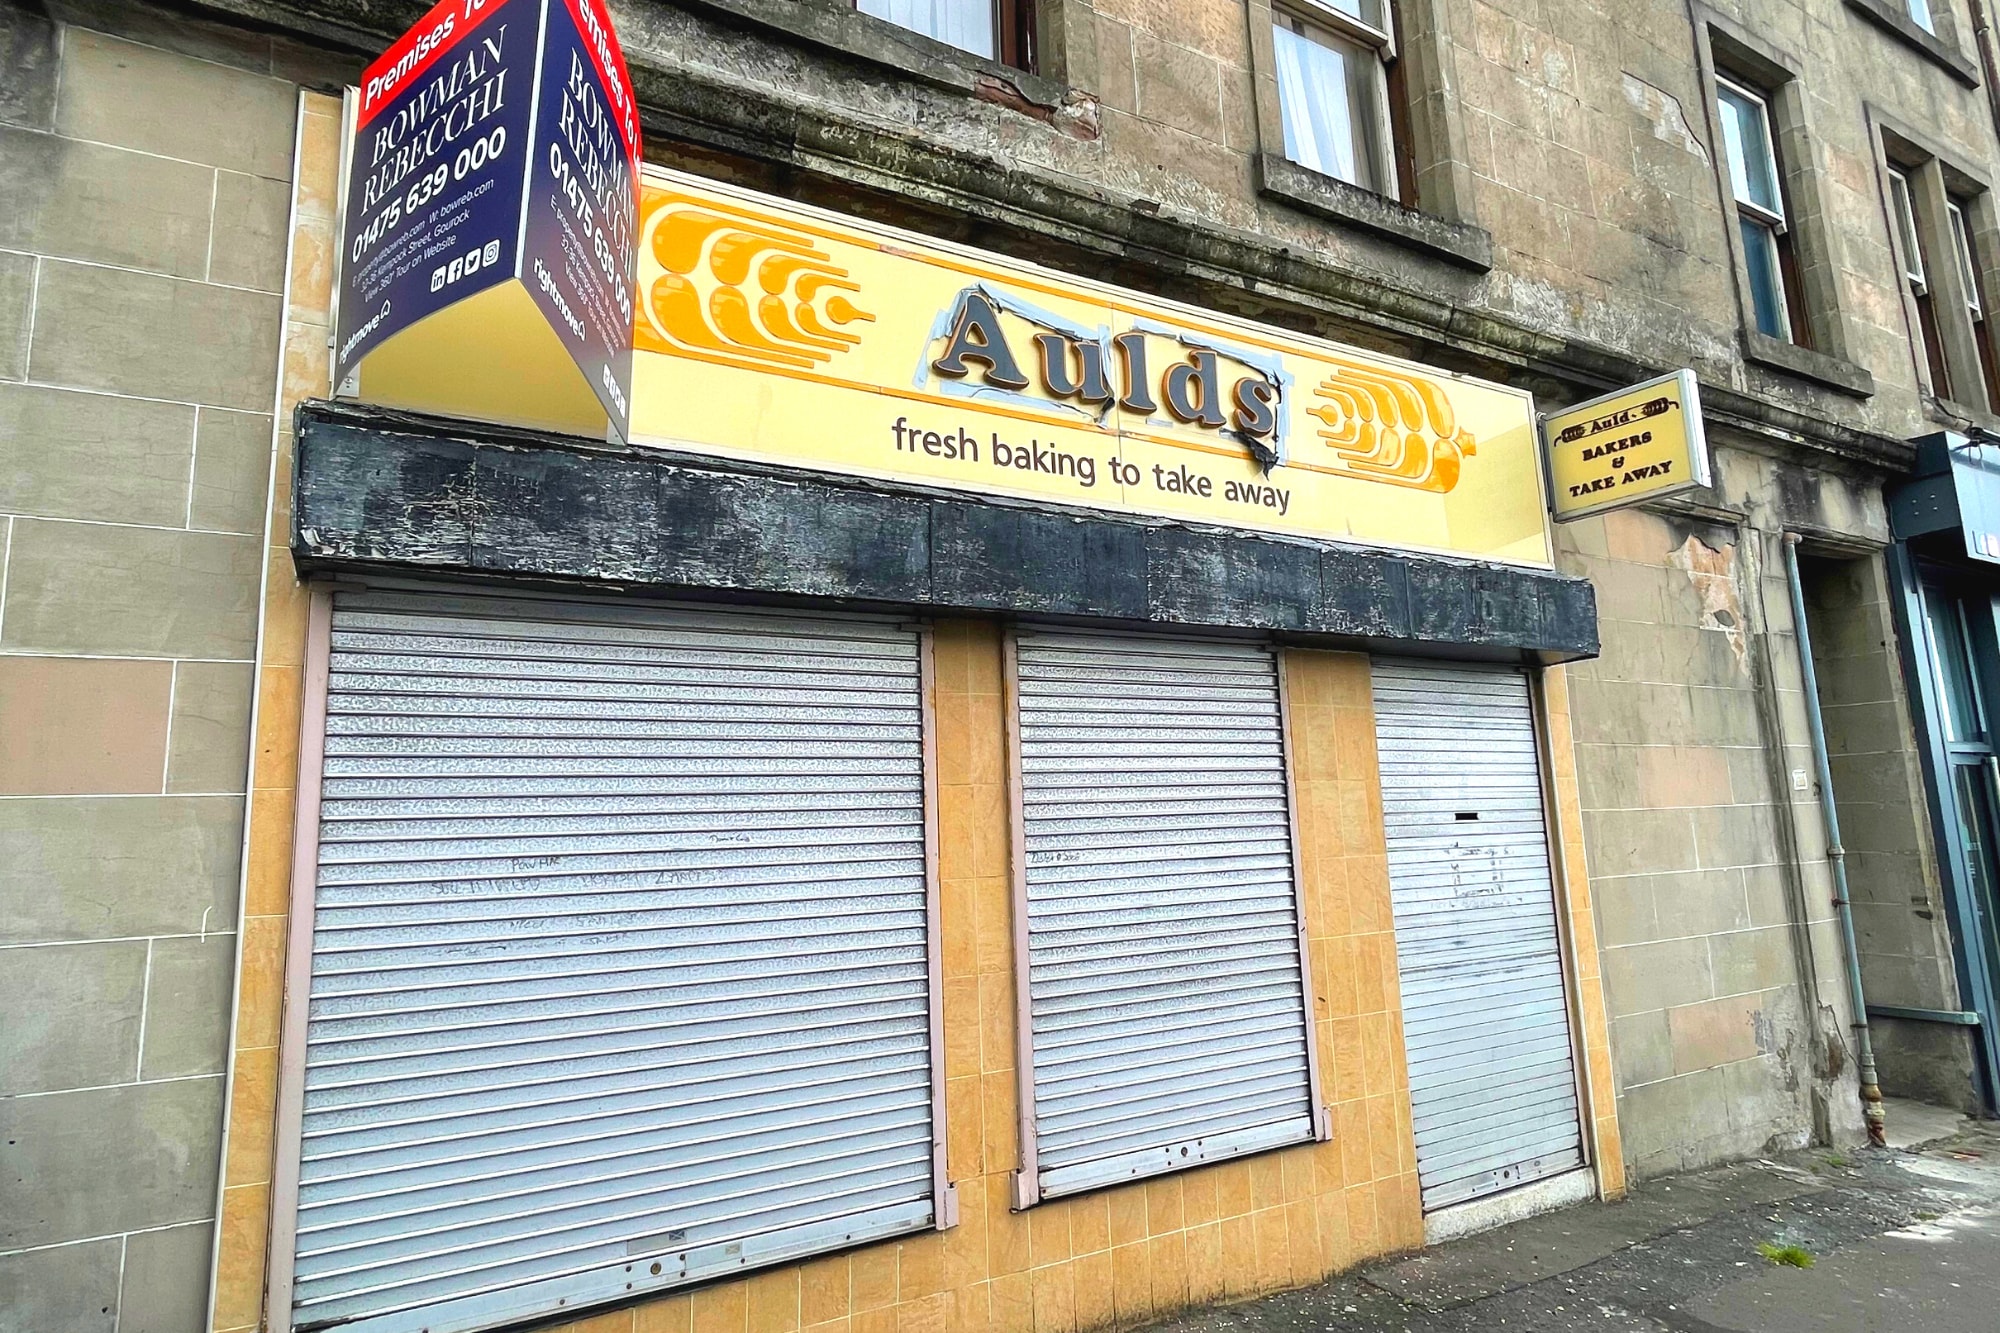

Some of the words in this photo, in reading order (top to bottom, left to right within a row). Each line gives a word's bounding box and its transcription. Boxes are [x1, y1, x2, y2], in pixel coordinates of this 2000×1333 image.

[364, 12, 456, 111] Premises
[370, 23, 508, 168] BOWMAN
[360, 68, 509, 217] REBECCHI
[558, 87, 632, 281] REBECCHI
[567, 46, 635, 232] BOWMAN
[352, 196, 403, 264] 01475
[405, 163, 449, 215] 639
[453, 126, 507, 182] 000
[433, 209, 470, 237] Gourock
[440, 179, 494, 218] bowreb.com
[549, 141, 594, 240] 01475
[593, 226, 616, 284] 639
[615, 273, 631, 326] 000
[395, 261, 411, 279] Tour
[411, 254, 422, 268] on
[423, 234, 457, 261] Website
[533, 256, 579, 336] rightmove
[339, 314, 380, 365] rightmove
[931, 292, 1279, 438] Aulds
[891, 417, 979, 463] fresh
[992, 431, 1097, 488] baking
[1107, 455, 1141, 486] to
[1151, 462, 1213, 498] take
[1224, 480, 1291, 517] away
[1569, 475, 1616, 498] TAKE
[1622, 460, 1673, 485] AWAY
[1582, 431, 1653, 461] BAKERS
[1611, 456, 1625, 469] &
